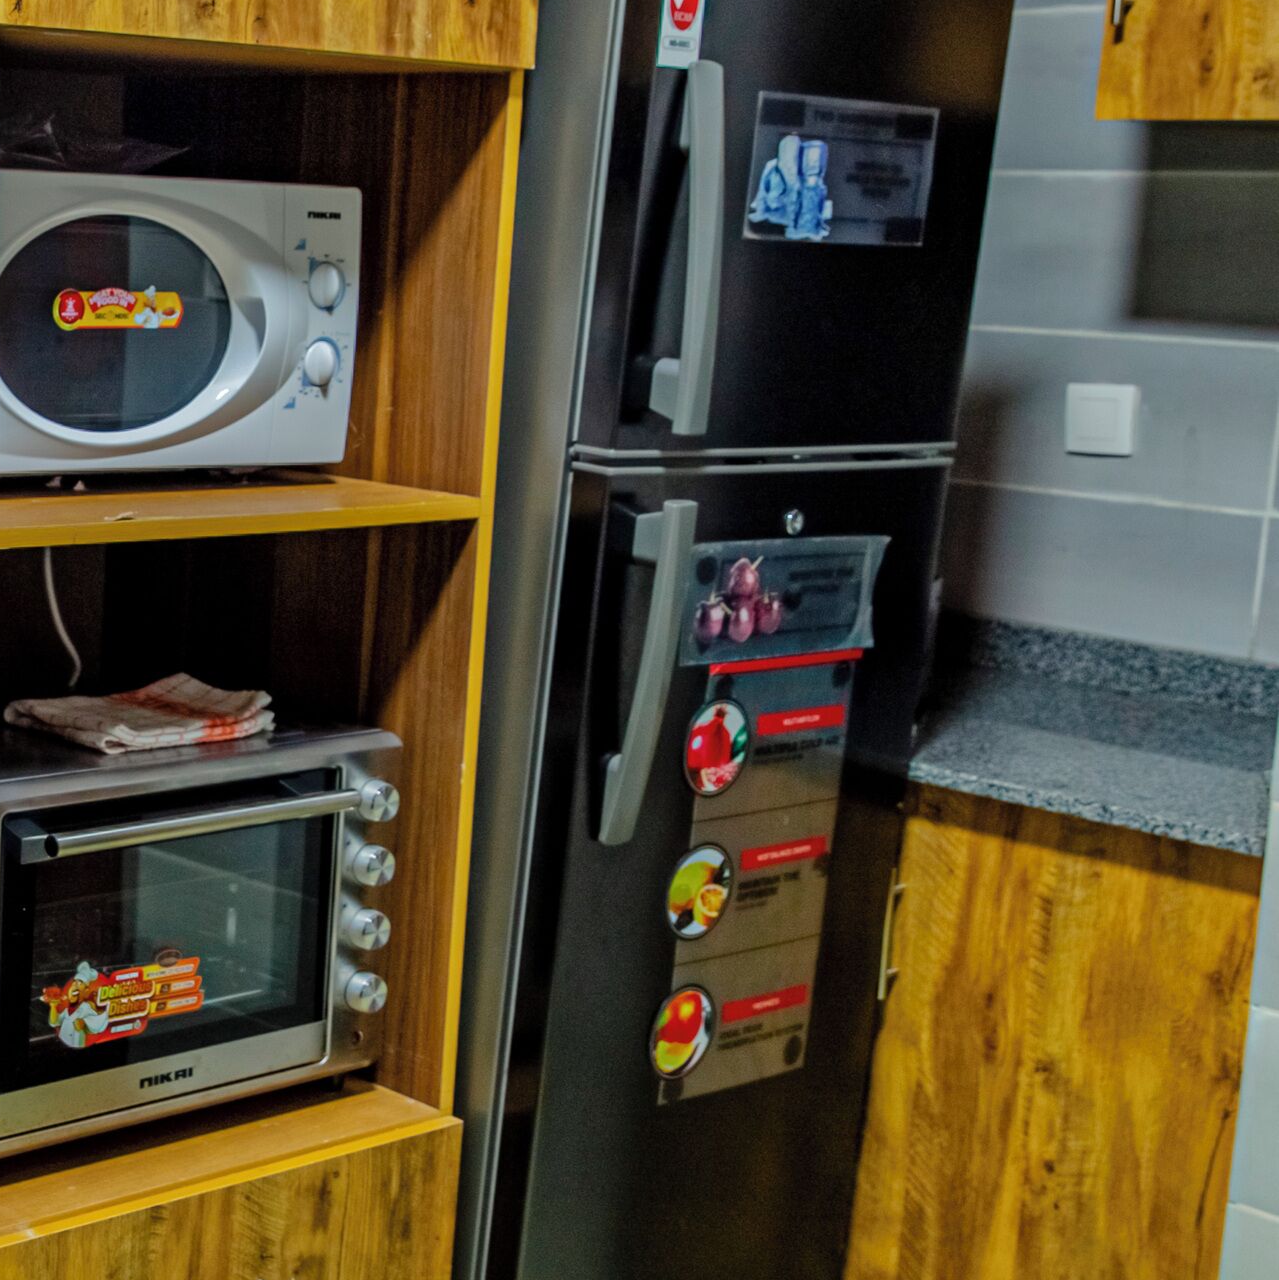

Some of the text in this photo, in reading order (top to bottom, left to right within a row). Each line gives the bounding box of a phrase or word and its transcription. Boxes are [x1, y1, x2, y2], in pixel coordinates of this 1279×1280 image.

[100, 980, 152, 1000] Delicious
[109, 999, 147, 1017] Dishes
[139, 1066, 193, 1089] NIKAI
